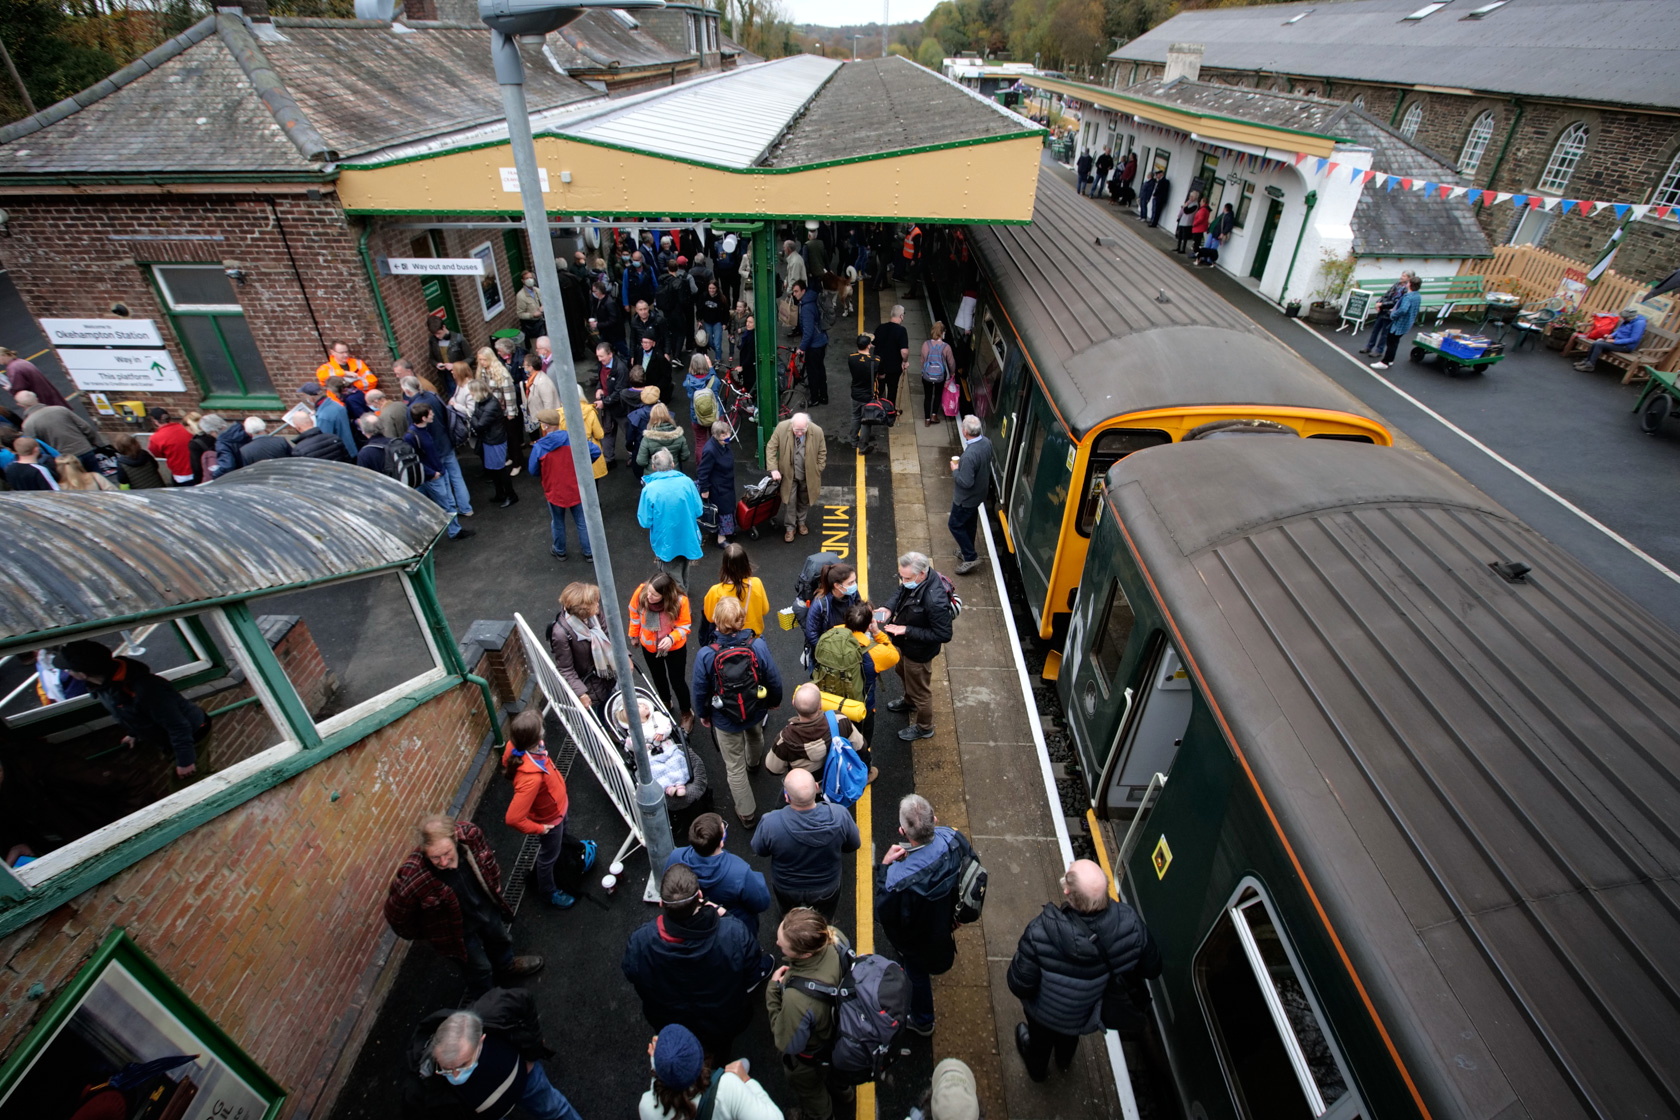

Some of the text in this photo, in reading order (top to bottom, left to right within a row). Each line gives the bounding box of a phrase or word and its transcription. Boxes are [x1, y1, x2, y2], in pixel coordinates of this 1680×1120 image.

[412, 263, 428, 271] Way
[56, 330, 150, 340] Okehampton Station
[114, 356, 132, 364] Way
[820, 505, 850, 560] MIND
